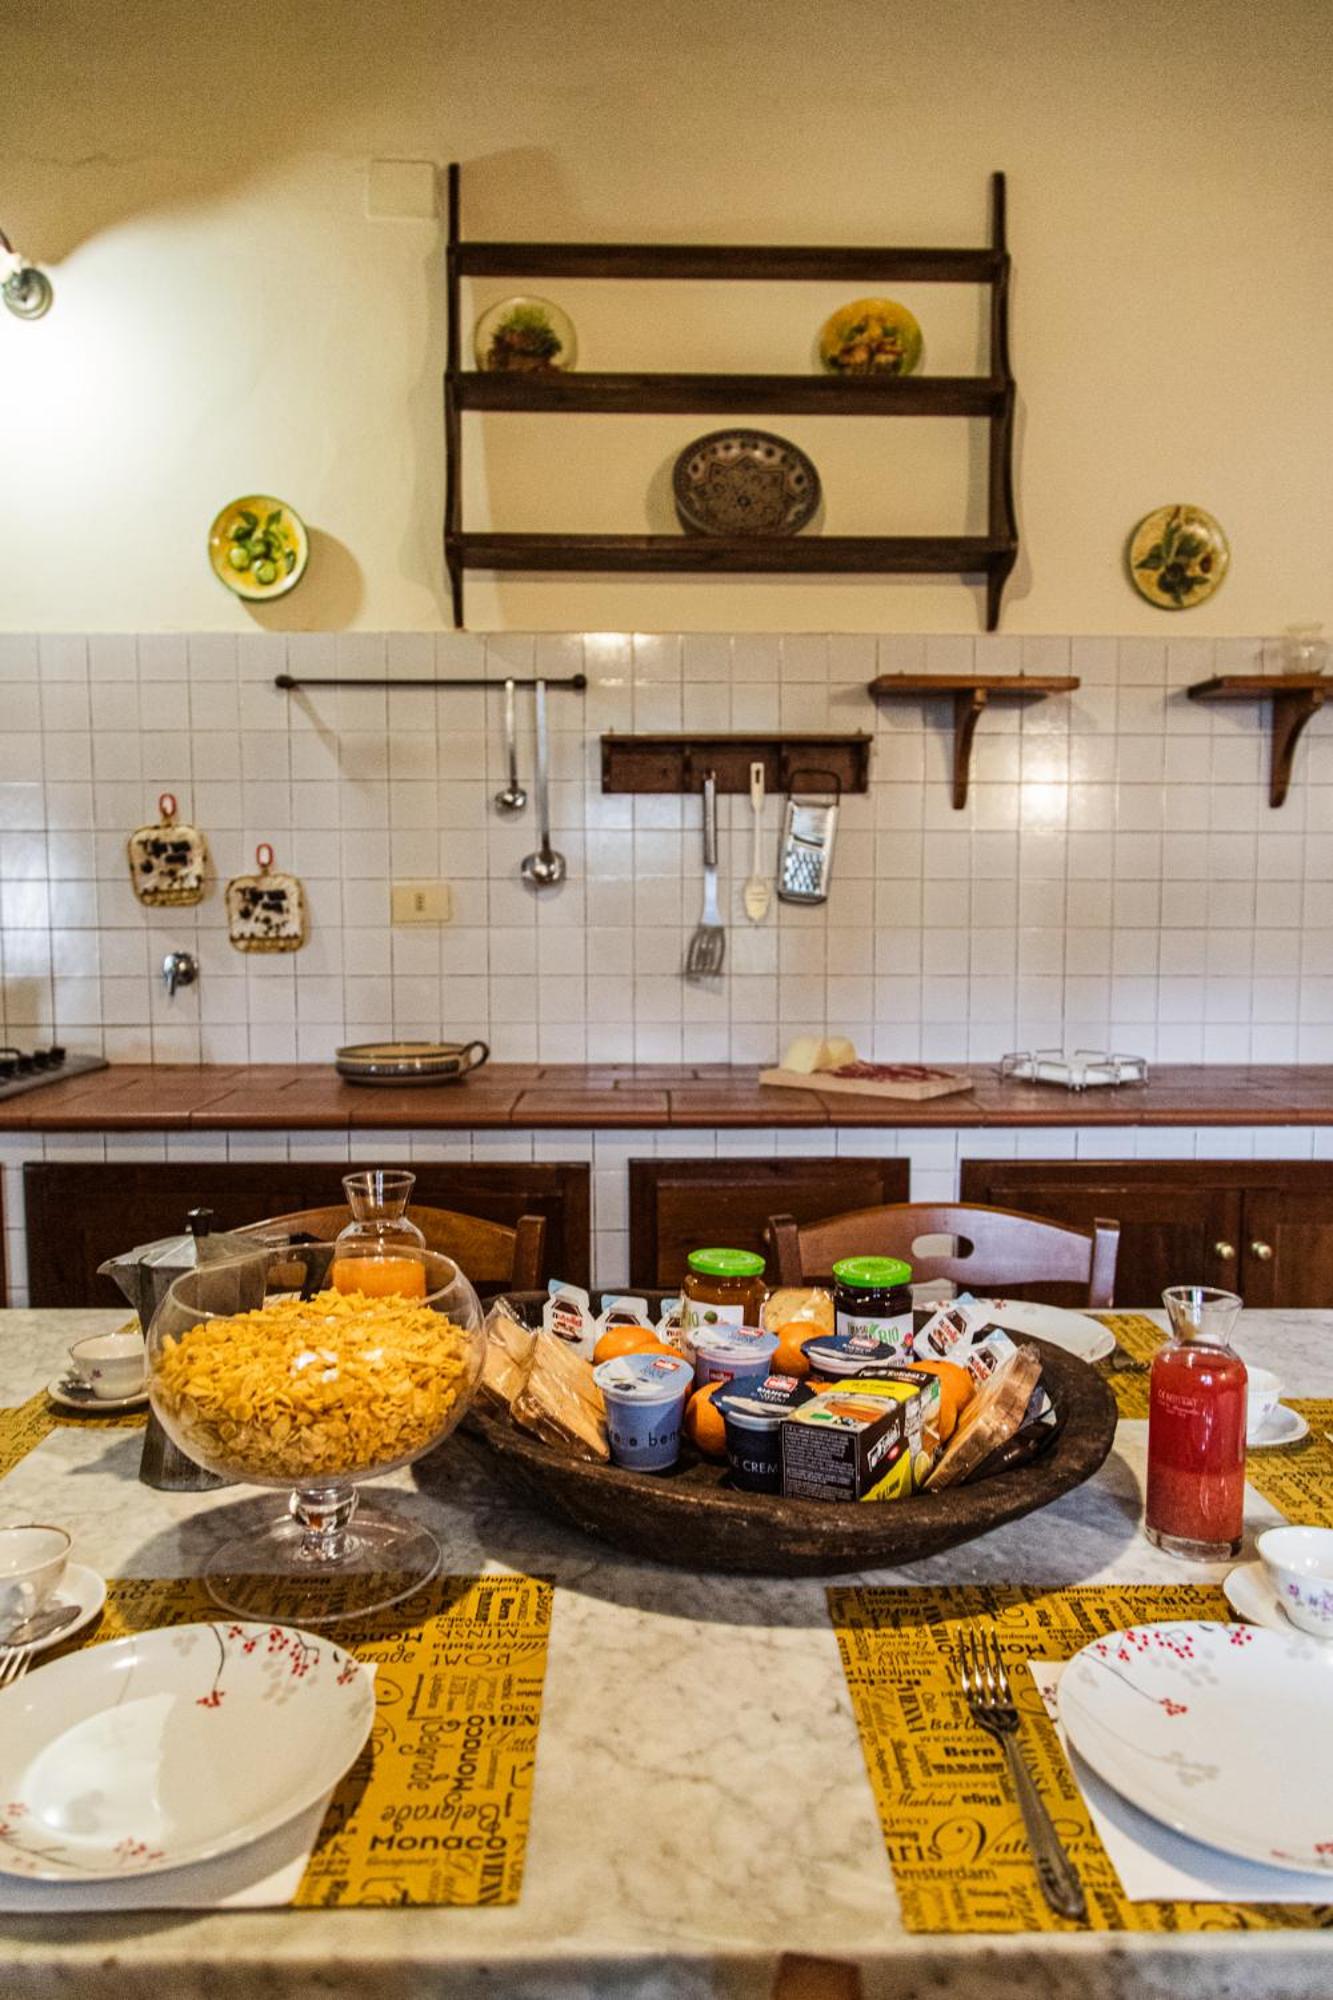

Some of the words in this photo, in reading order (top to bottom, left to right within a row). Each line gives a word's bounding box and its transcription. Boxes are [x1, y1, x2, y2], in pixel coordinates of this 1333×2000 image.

[879, 1326, 900, 1344] BIO
[453, 1714, 486, 1791] Monaco
[944, 1746, 995, 1757] Bern
[961, 1793, 1001, 1807] Riga
[379, 1791, 501, 1835] Belgrade
[369, 1834, 508, 1852] Monaco
